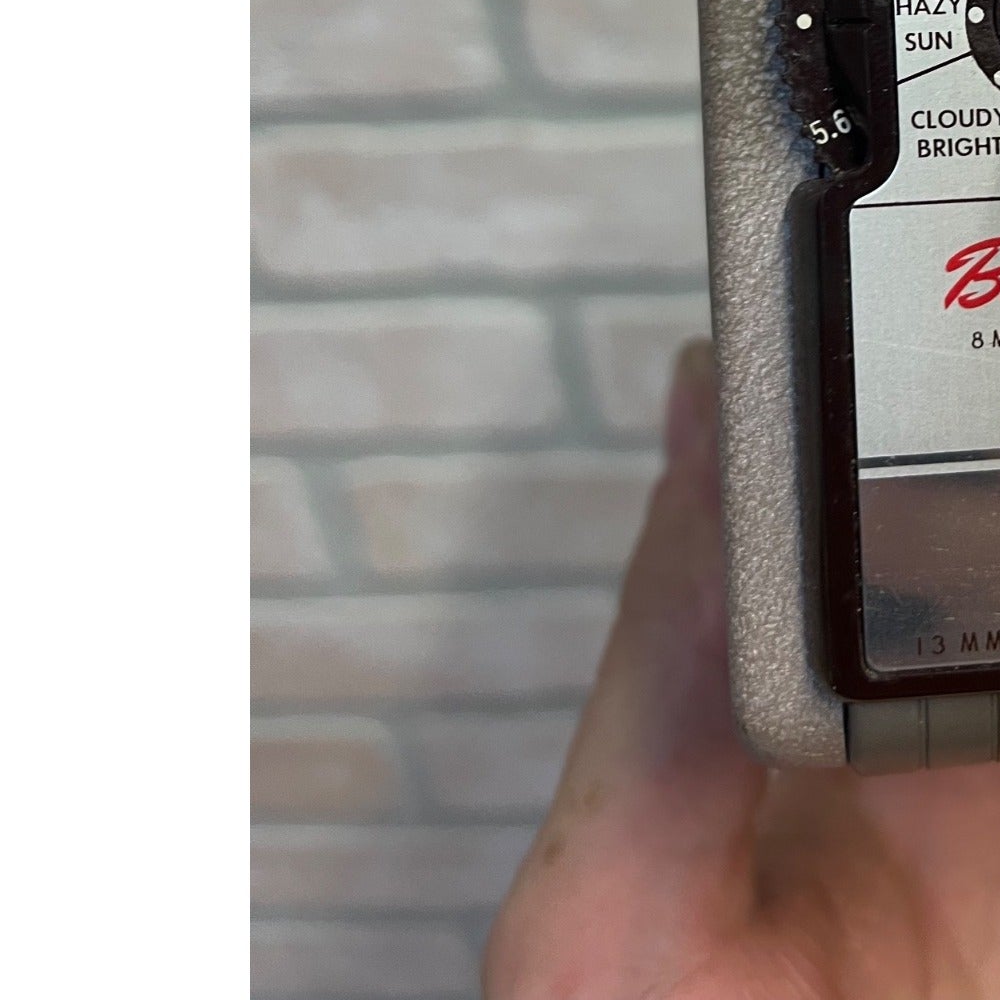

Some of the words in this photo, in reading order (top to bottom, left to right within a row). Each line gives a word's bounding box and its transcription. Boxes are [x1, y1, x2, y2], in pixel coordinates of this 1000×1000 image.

[905, 31, 953, 52] SUN
[809, 108, 852, 146] 5.6
[917, 634, 946, 656] 13
